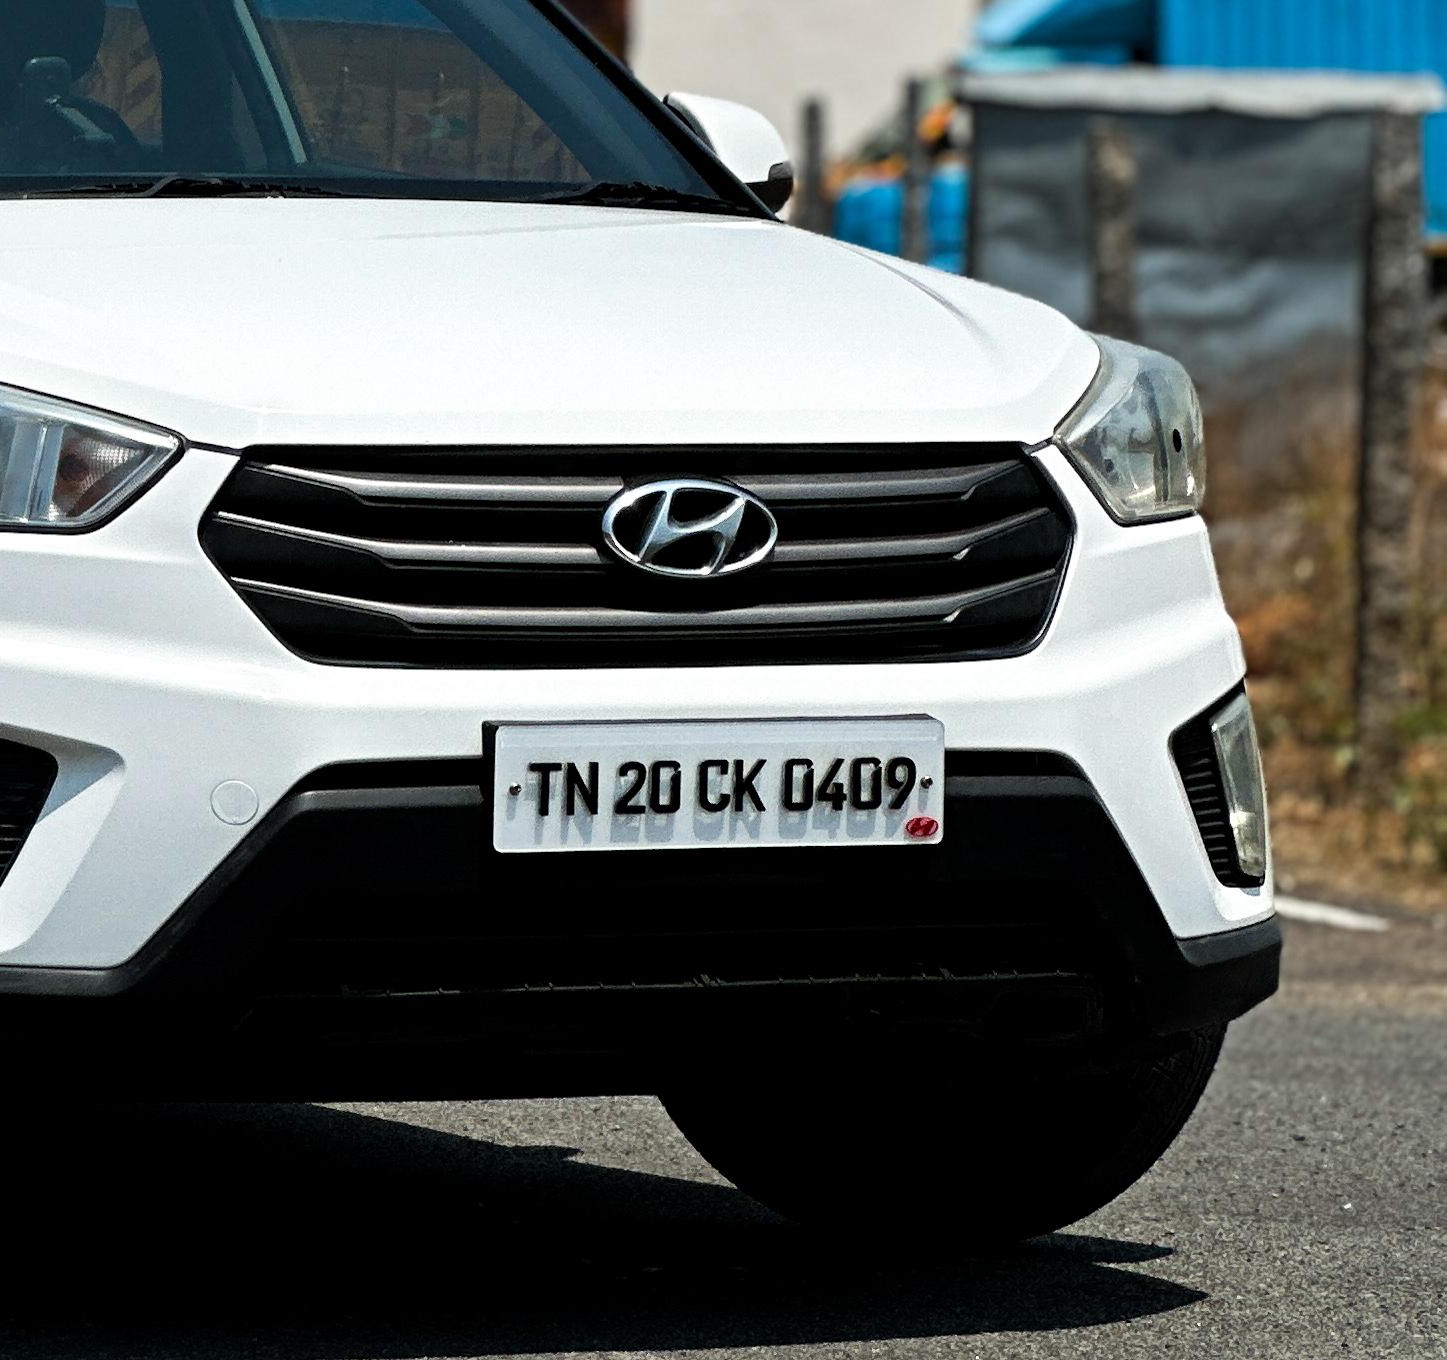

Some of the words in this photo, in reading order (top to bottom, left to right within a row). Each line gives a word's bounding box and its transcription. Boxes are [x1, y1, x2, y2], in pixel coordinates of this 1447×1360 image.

[529, 761, 599, 817] TN
[615, 759, 682, 815] 20
[699, 758, 767, 813] CK
[783, 756, 917, 811] 0409
